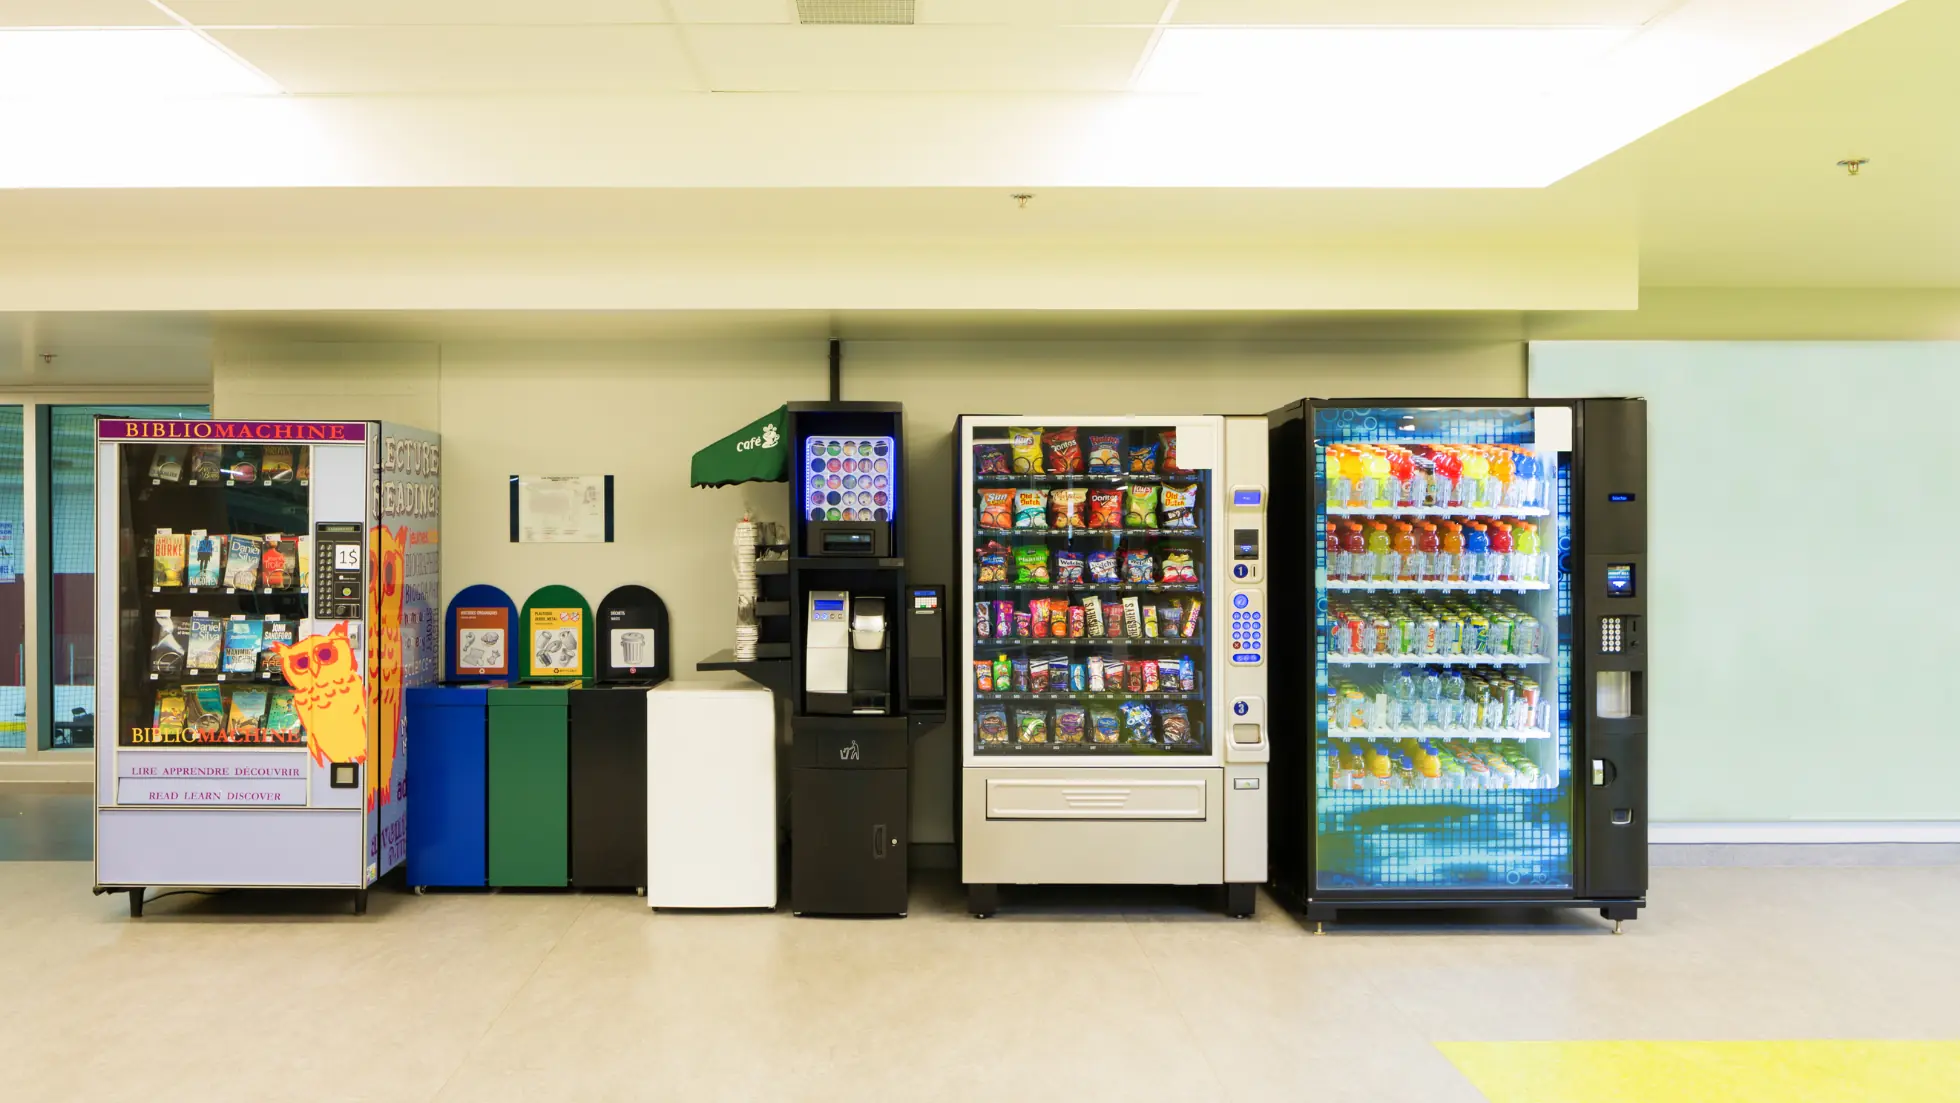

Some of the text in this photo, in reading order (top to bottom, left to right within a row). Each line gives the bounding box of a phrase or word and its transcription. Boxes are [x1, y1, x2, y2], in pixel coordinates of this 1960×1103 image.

[125, 422, 346, 440] BIBLIOMACHINE
[736, 436, 762, 453] café
[1051, 439, 1077, 452] Doritos
[987, 493, 1008, 502] Sun
[1092, 494, 1118, 502] Doritos
[155, 544, 183, 557] BURKE
[231, 541, 260, 555] Daniel
[238, 552, 260, 565] Silva
[339, 548, 358, 567] 1$
[1238, 566, 1243, 577] 1
[192, 621, 221, 632] Daniel
[272, 623, 286, 632] JOHN
[199, 631, 221, 641] Silva
[264, 631, 292, 640] SANDFORD
[1238, 703, 1245, 714] 3
[131, 727, 301, 744] BIBLIOMACHINE
[131, 765, 300, 777] LIRE APPRENDRE DÉCOUVRIR
[149, 791, 281, 801] READ LEARN DISCOVER
